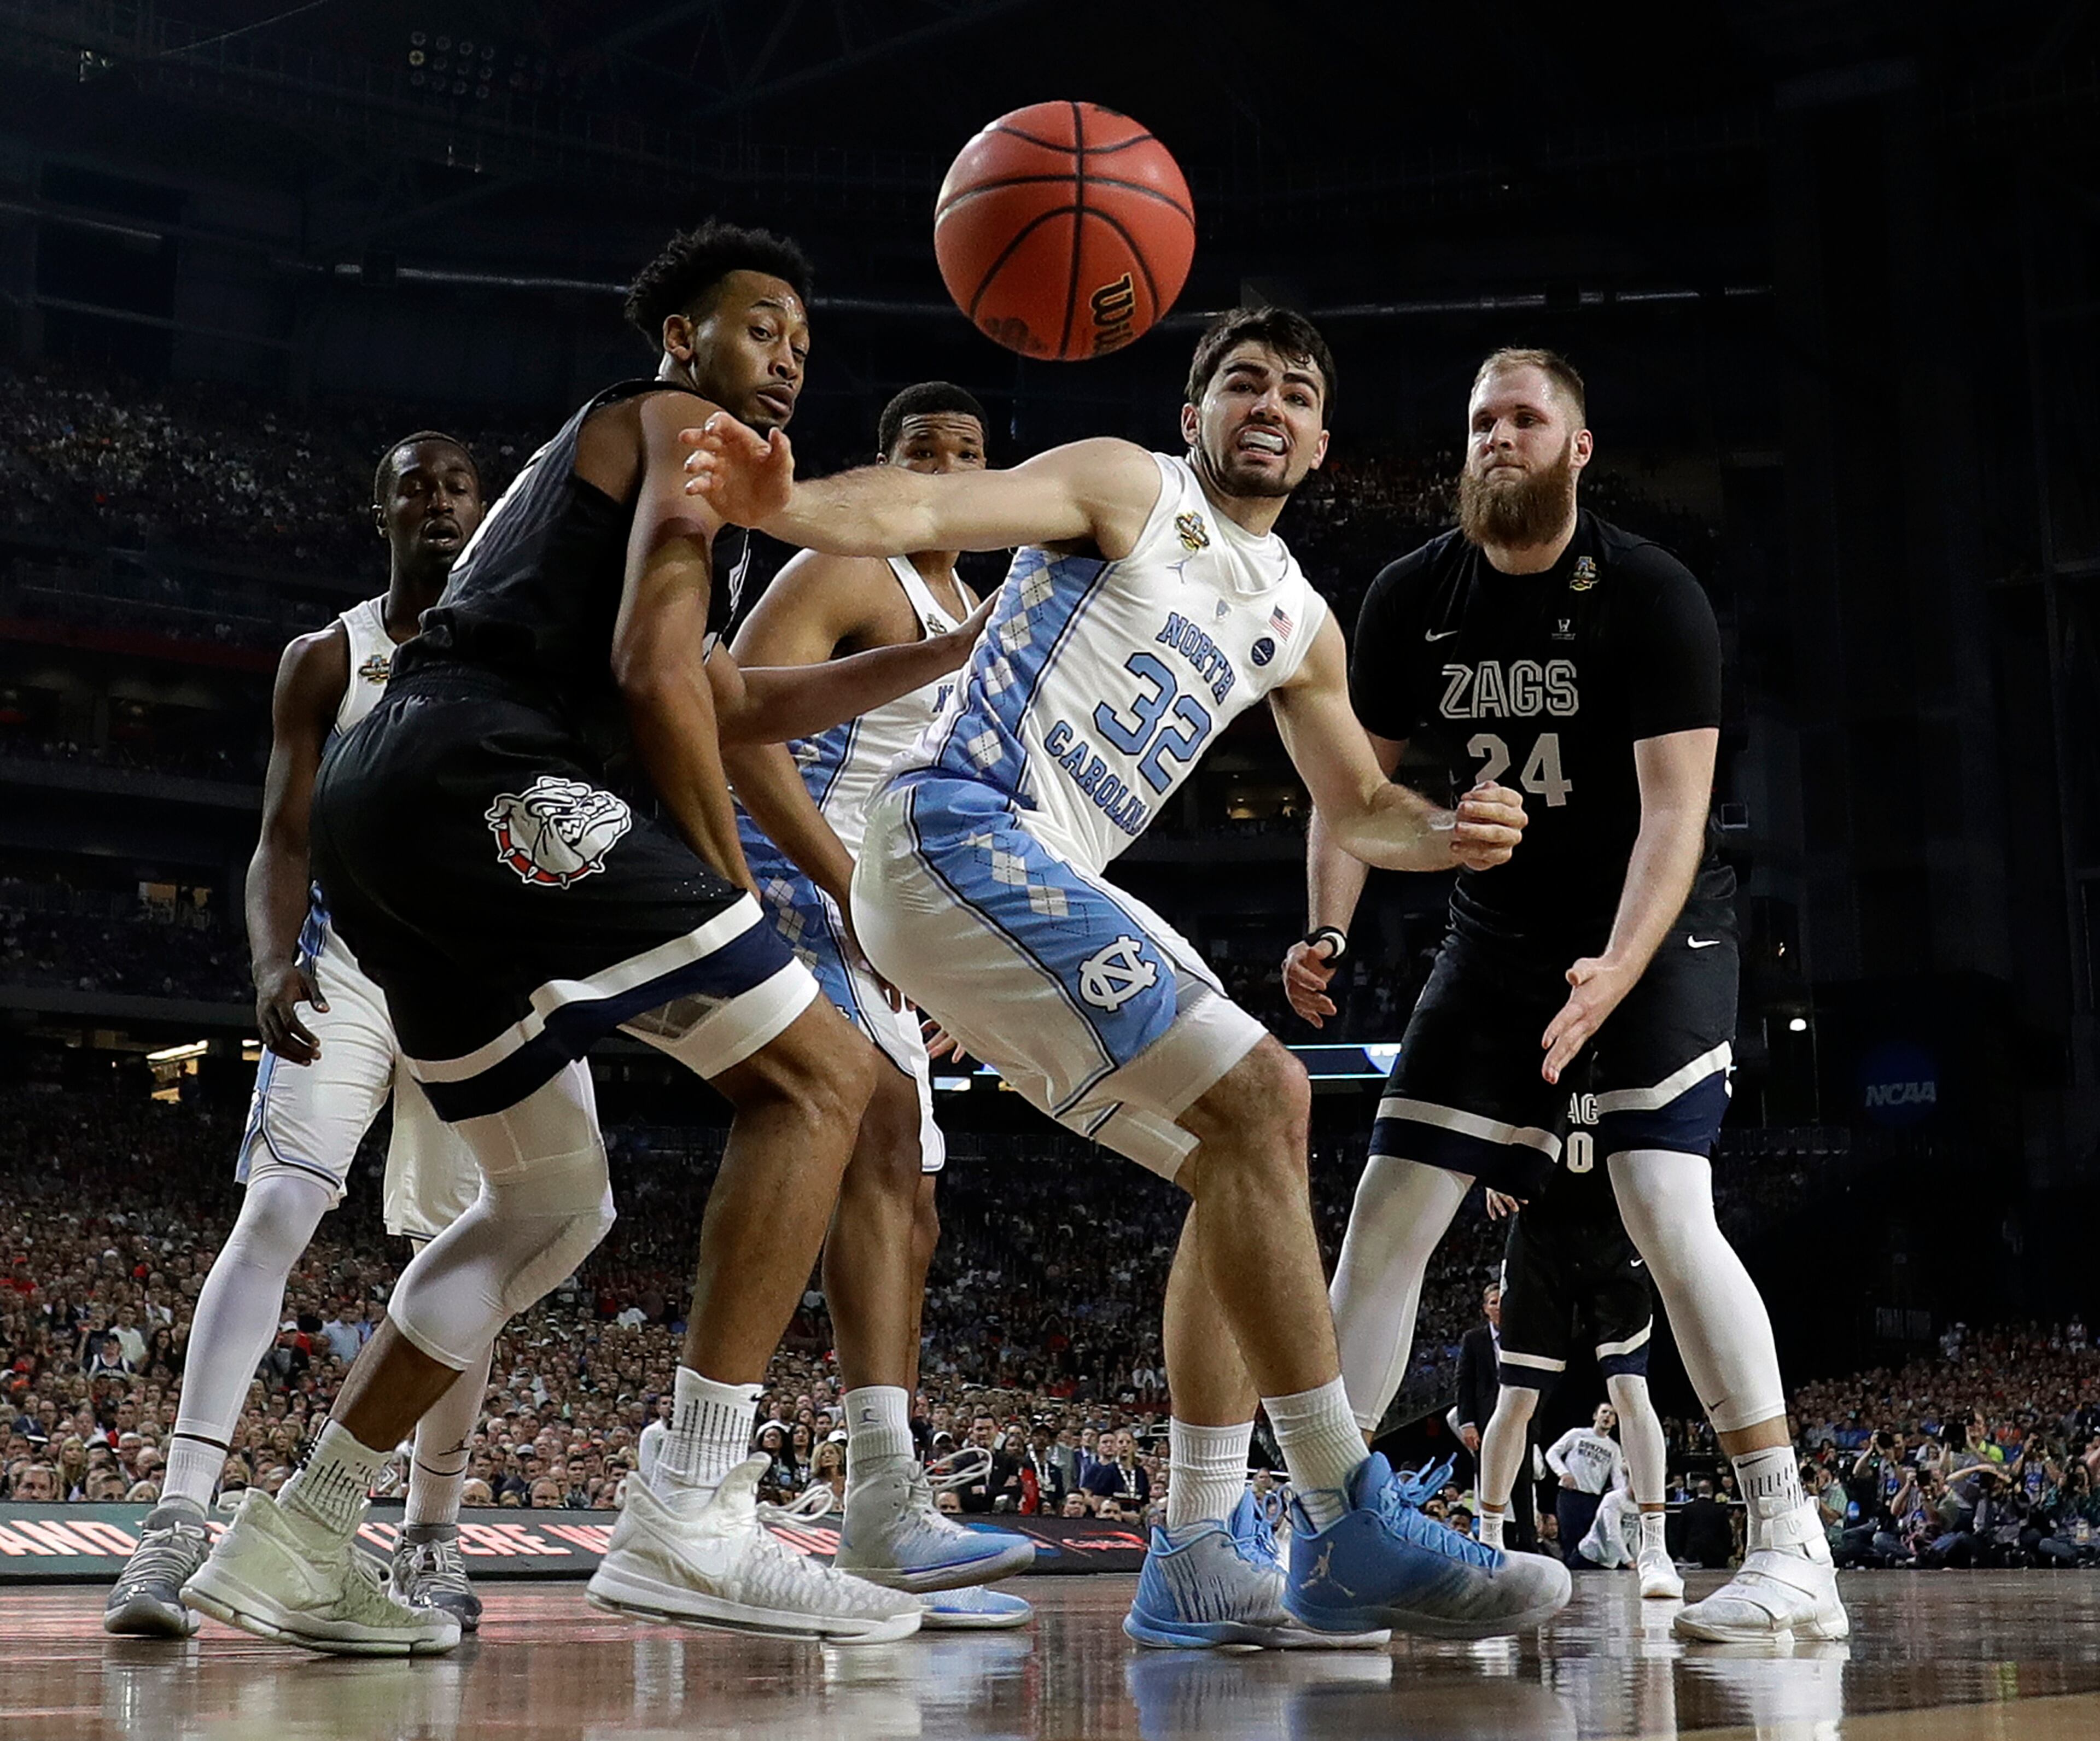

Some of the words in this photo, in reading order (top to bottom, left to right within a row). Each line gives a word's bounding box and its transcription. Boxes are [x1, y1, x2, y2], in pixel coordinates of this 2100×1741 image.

[1155, 611, 1236, 705] NORTH
[1439, 659, 1579, 719] ZAGS
[1093, 652, 1212, 796] 32
[1044, 720, 1152, 836] CAROLIN
[1467, 733, 1573, 807] 24
[1864, 1080, 1937, 1107] NCAA
